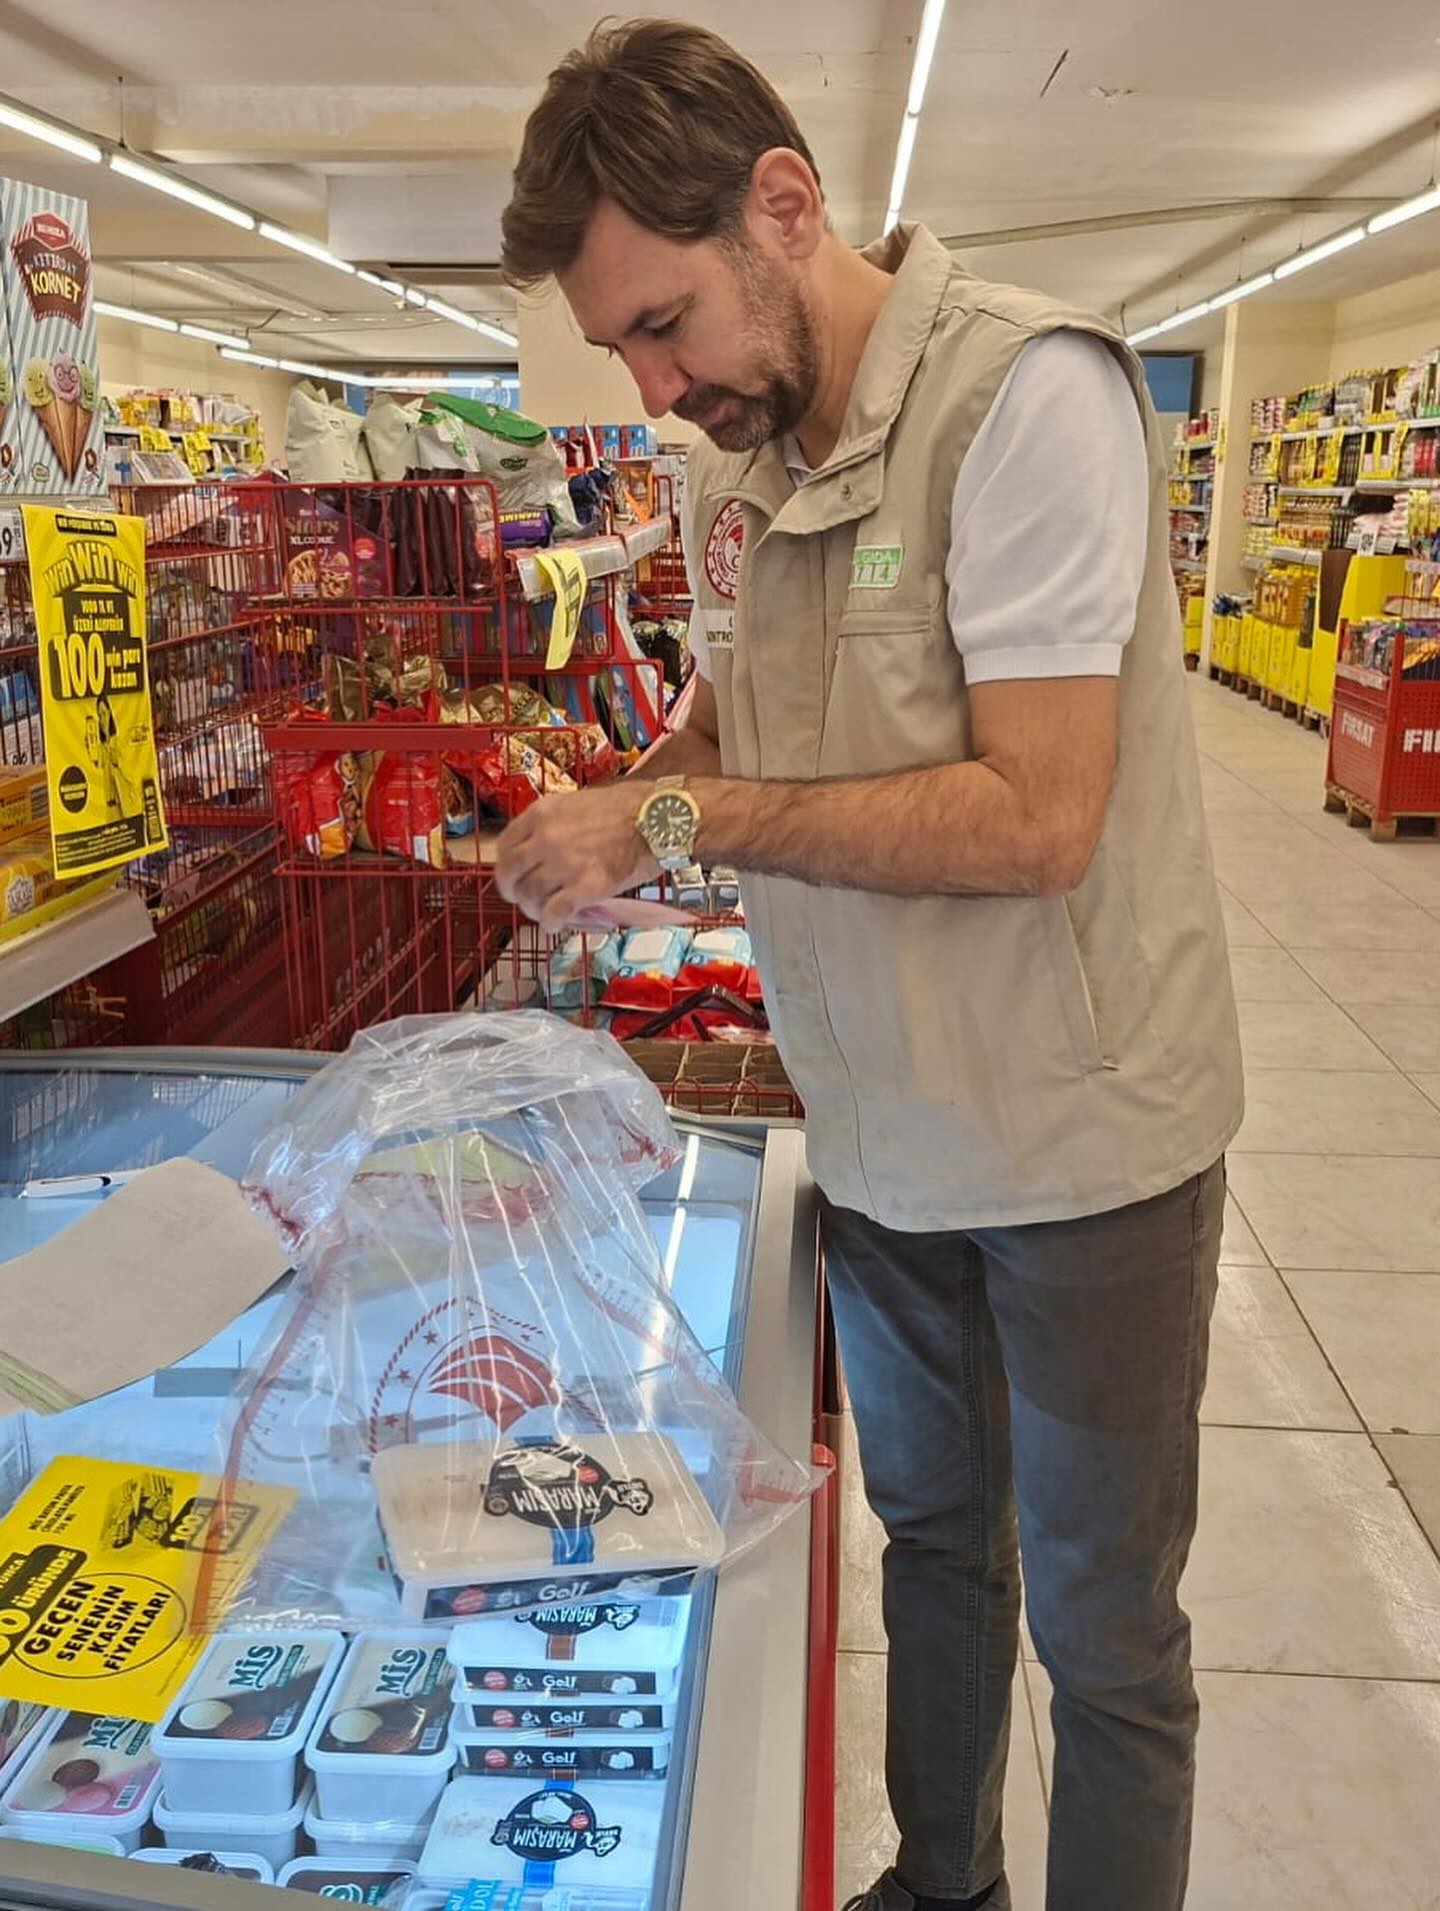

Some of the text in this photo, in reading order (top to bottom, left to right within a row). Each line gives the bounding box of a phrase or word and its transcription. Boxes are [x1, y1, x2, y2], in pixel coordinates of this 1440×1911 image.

[31, 270, 81, 304] KORNET
[68, 541, 114, 581] Win
[54, 633, 105, 698] 100
[12, 1550, 77, 1609] ÜRÜNDE
[539, 1581, 590, 1601] Golf
[23, 1580, 95, 1655] GEÇEN
[56, 1585, 125, 1662] SENENİN
[87, 1600, 138, 1653] KASIM
[104, 1591, 172, 1671] FİYATLARI
[542, 1675, 577, 1688] Golf
[550, 1711, 586, 1724] Golf
[542, 1752, 576, 1765] Golf
